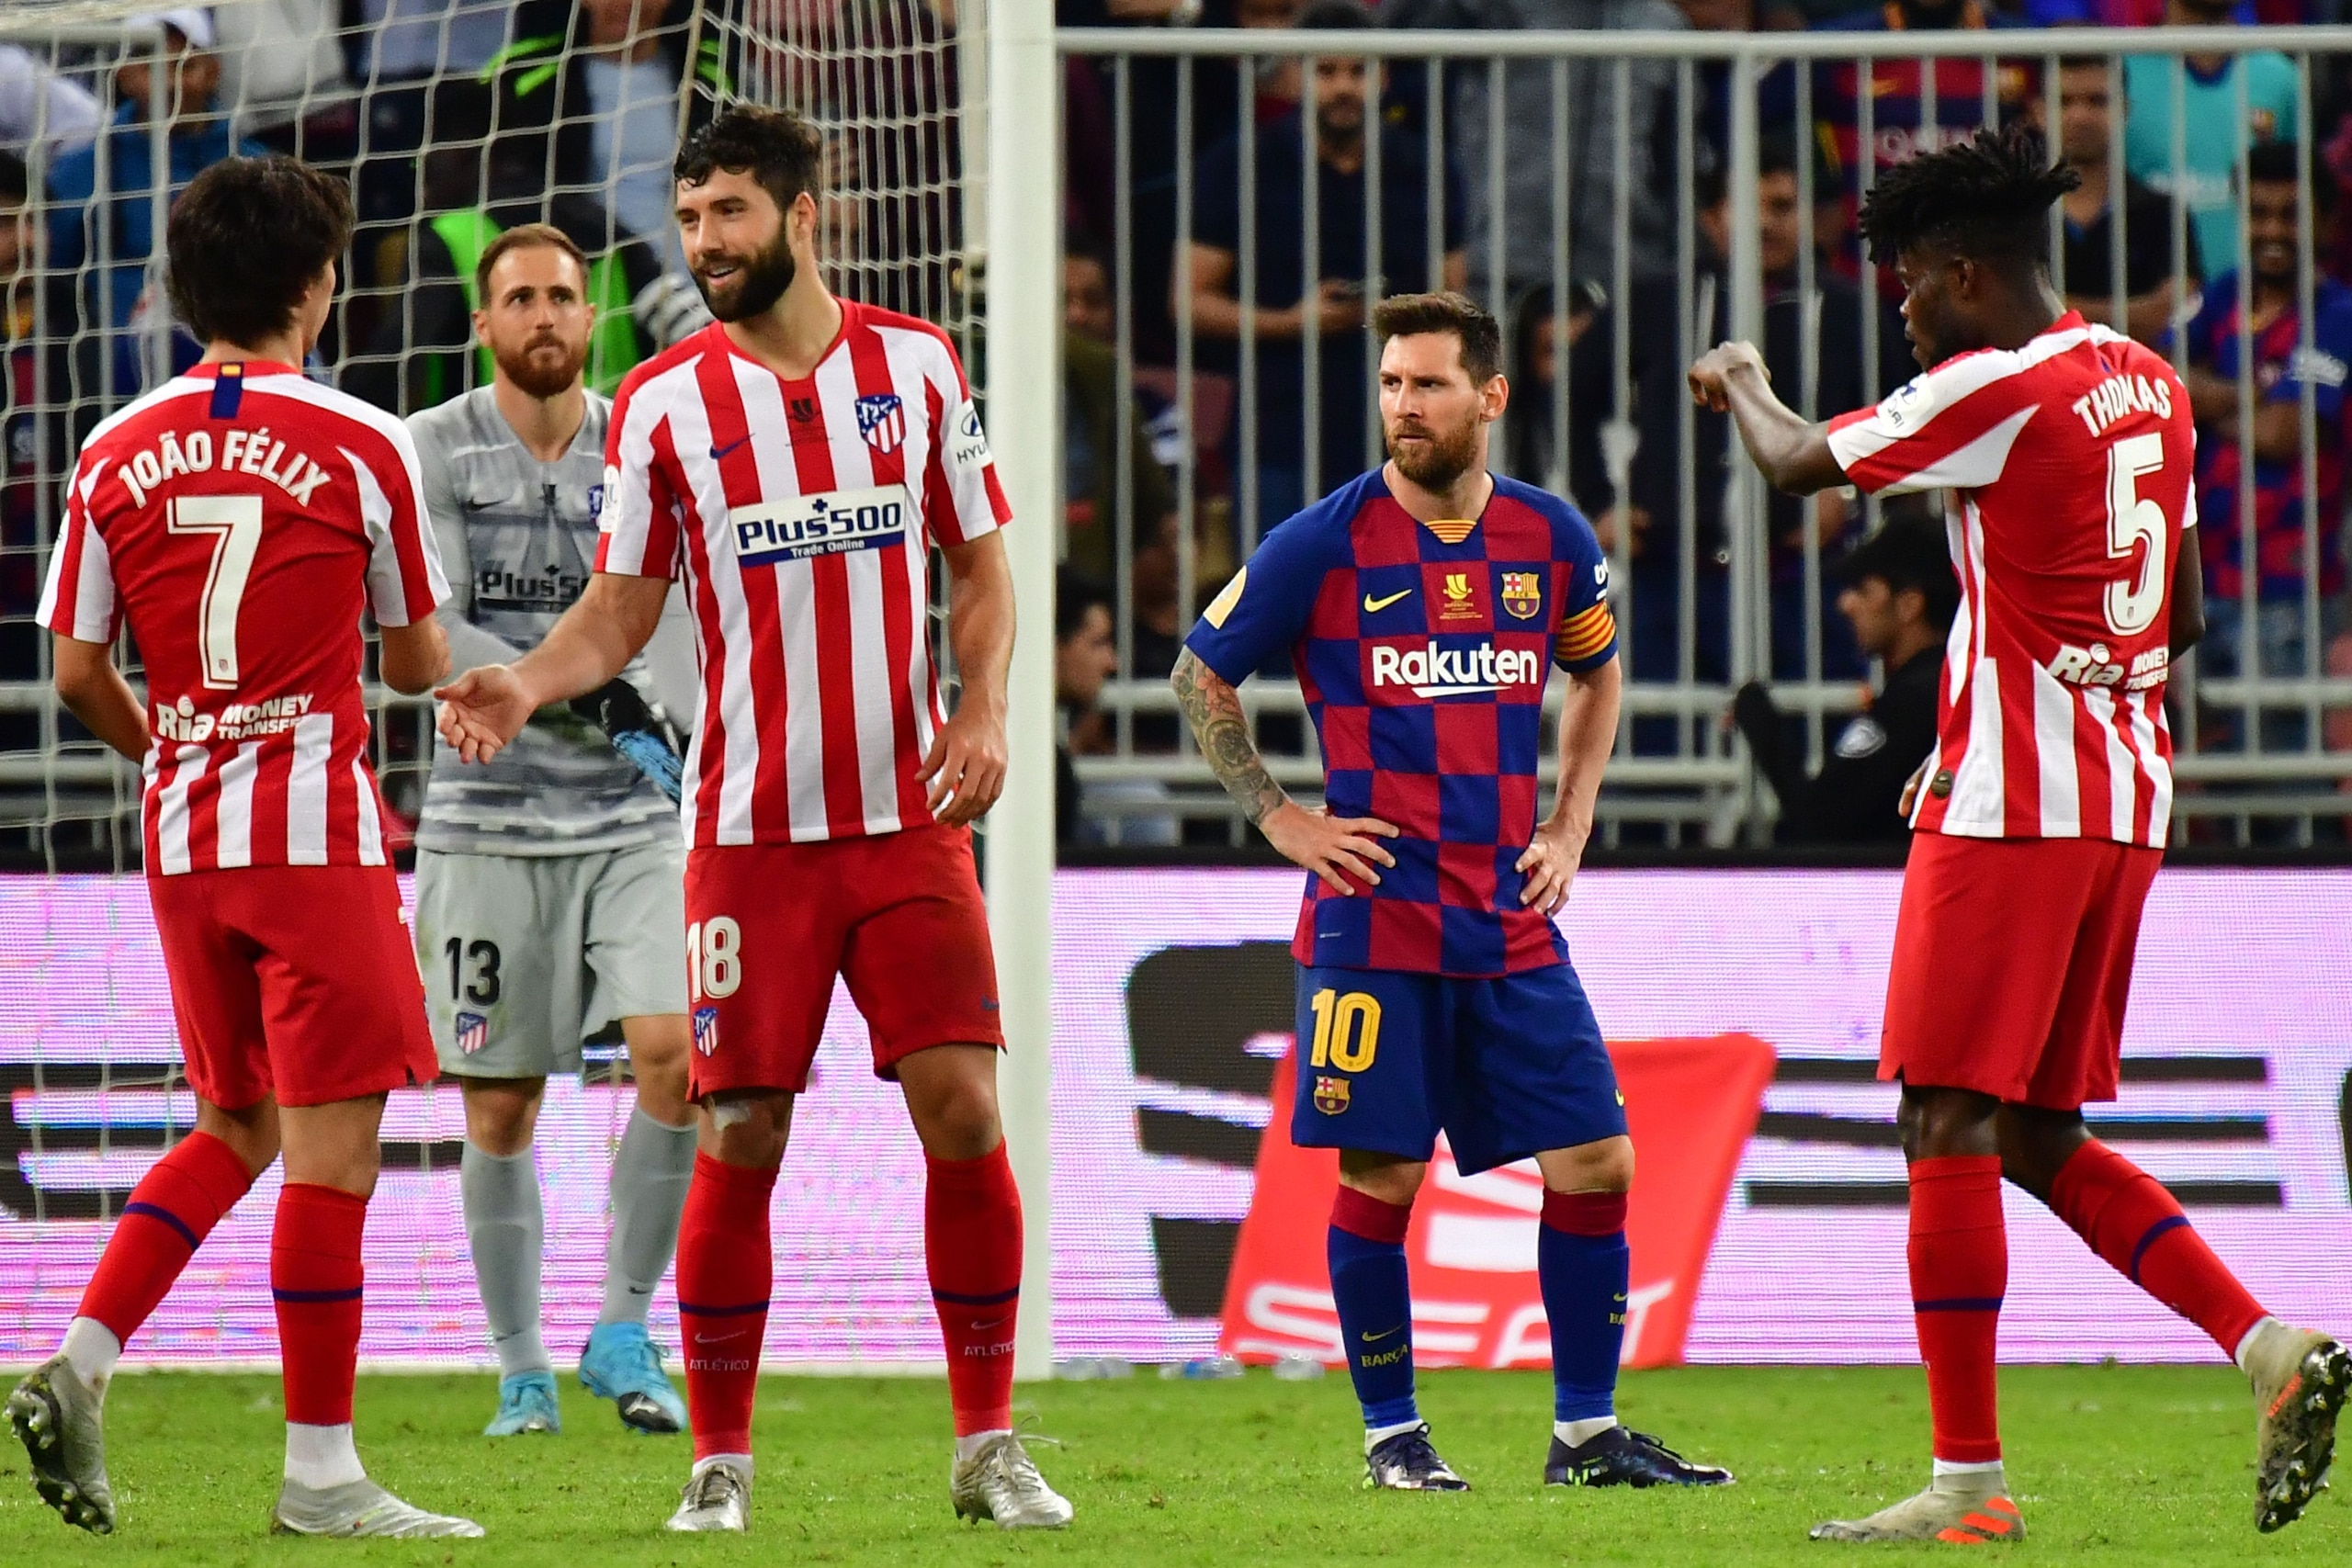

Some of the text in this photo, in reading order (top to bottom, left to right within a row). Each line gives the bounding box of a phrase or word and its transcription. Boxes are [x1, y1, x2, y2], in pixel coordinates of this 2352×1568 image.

[2072, 373, 2173, 437] THOMAS
[118, 426, 332, 509] JOÃO FÉLIX
[737, 502, 901, 550] Plus500
[790, 538, 865, 558] Trade Online
[2103, 431, 2167, 637] 5
[165, 494, 263, 690] 7
[1372, 640, 1538, 687] Rakuten
[2047, 643, 2124, 685] Ria
[155, 692, 314, 742] Ria MONEY
[445, 937, 501, 1008] 13
[686, 915, 741, 1003] 18
[1310, 987, 1382, 1073] 10
[1361, 1344, 1408, 1367] BARÇA
